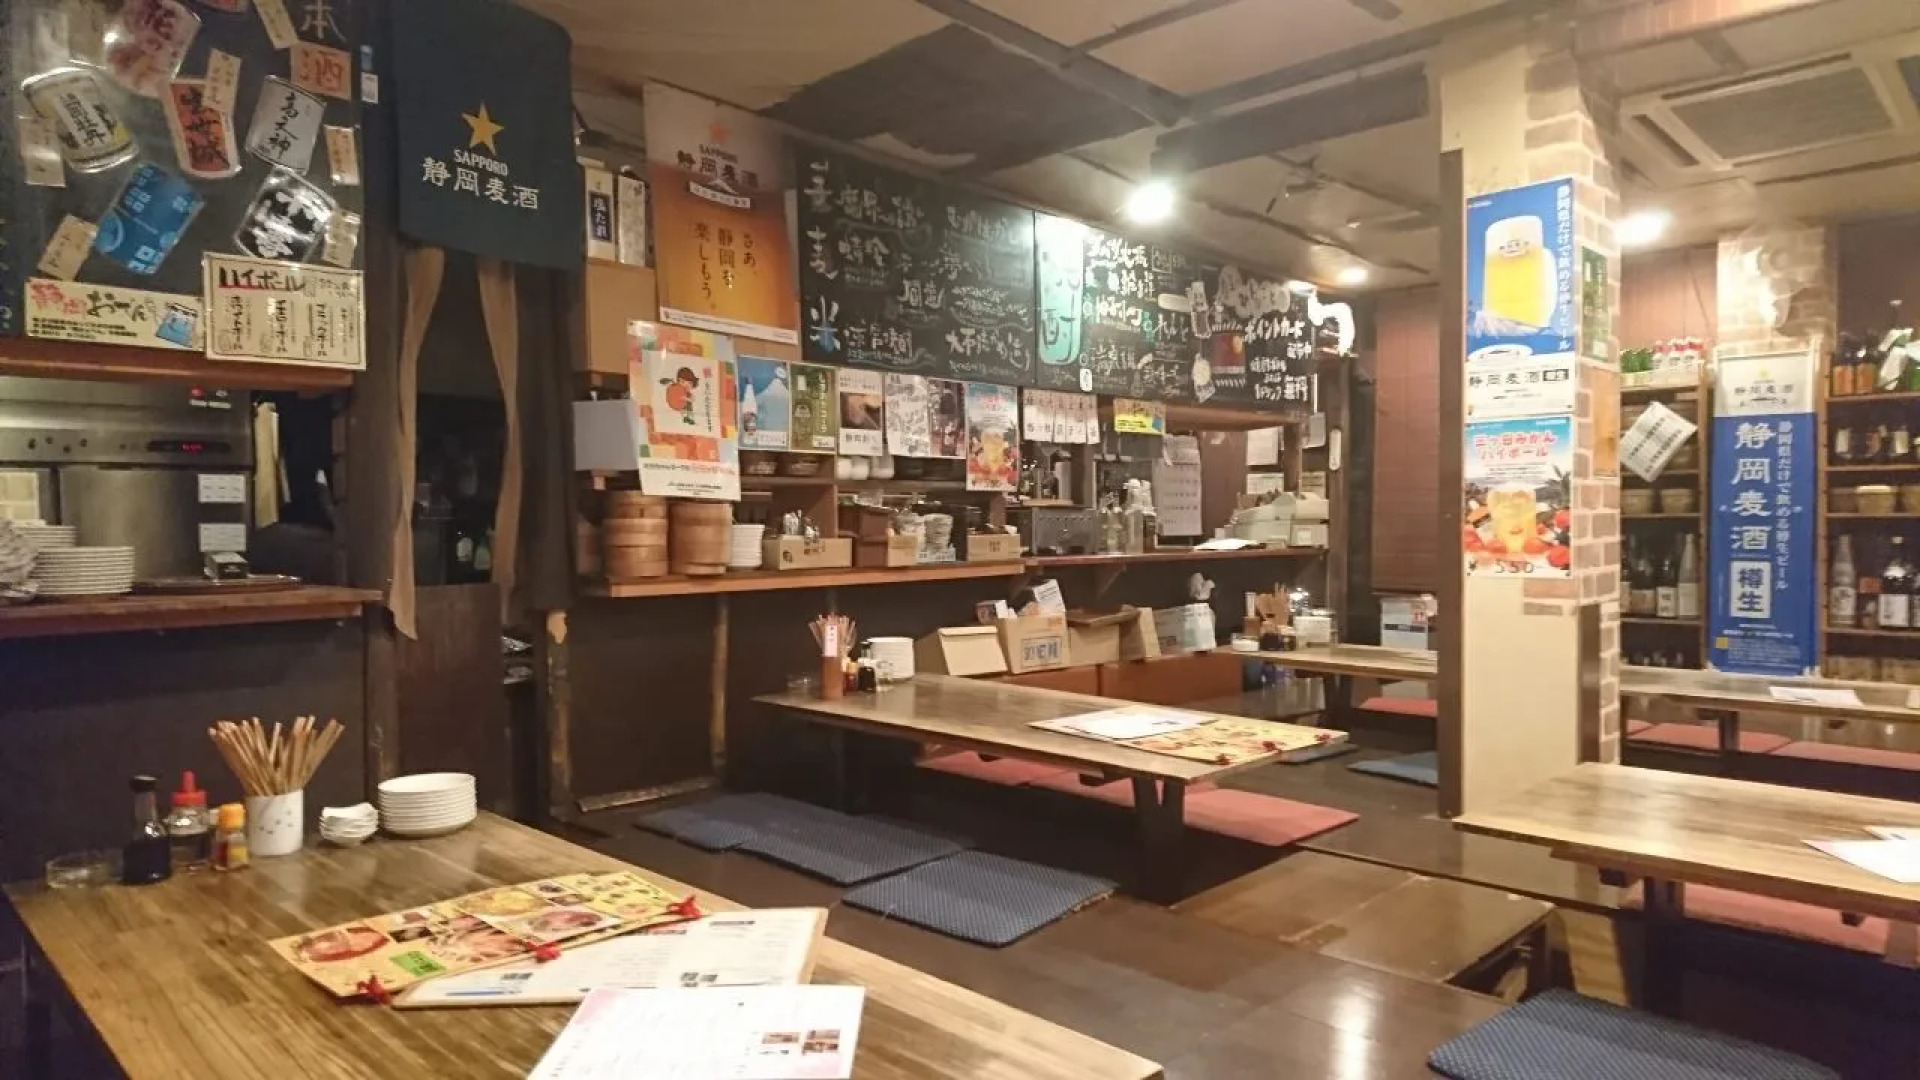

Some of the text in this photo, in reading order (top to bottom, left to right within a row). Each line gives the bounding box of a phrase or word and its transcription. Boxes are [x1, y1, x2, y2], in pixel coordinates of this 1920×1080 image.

[422, 157, 540, 210] 静岡麦酒
[453, 149, 508, 176] SAPPORO
[677, 150, 759, 188] 静岡麦酒
[218, 266, 307, 293] ハイボール
[694, 221, 717, 310] 楽しもう。
[717, 226, 736, 288] 静岡を
[809, 295, 841, 352] 米
[1480, 448, 1549, 461] ハイボール
[1730, 422, 1777, 550] 静岡麦酒
[1496, 561, 1535, 574] 550
[1737, 567, 1764, 613] 樽生
